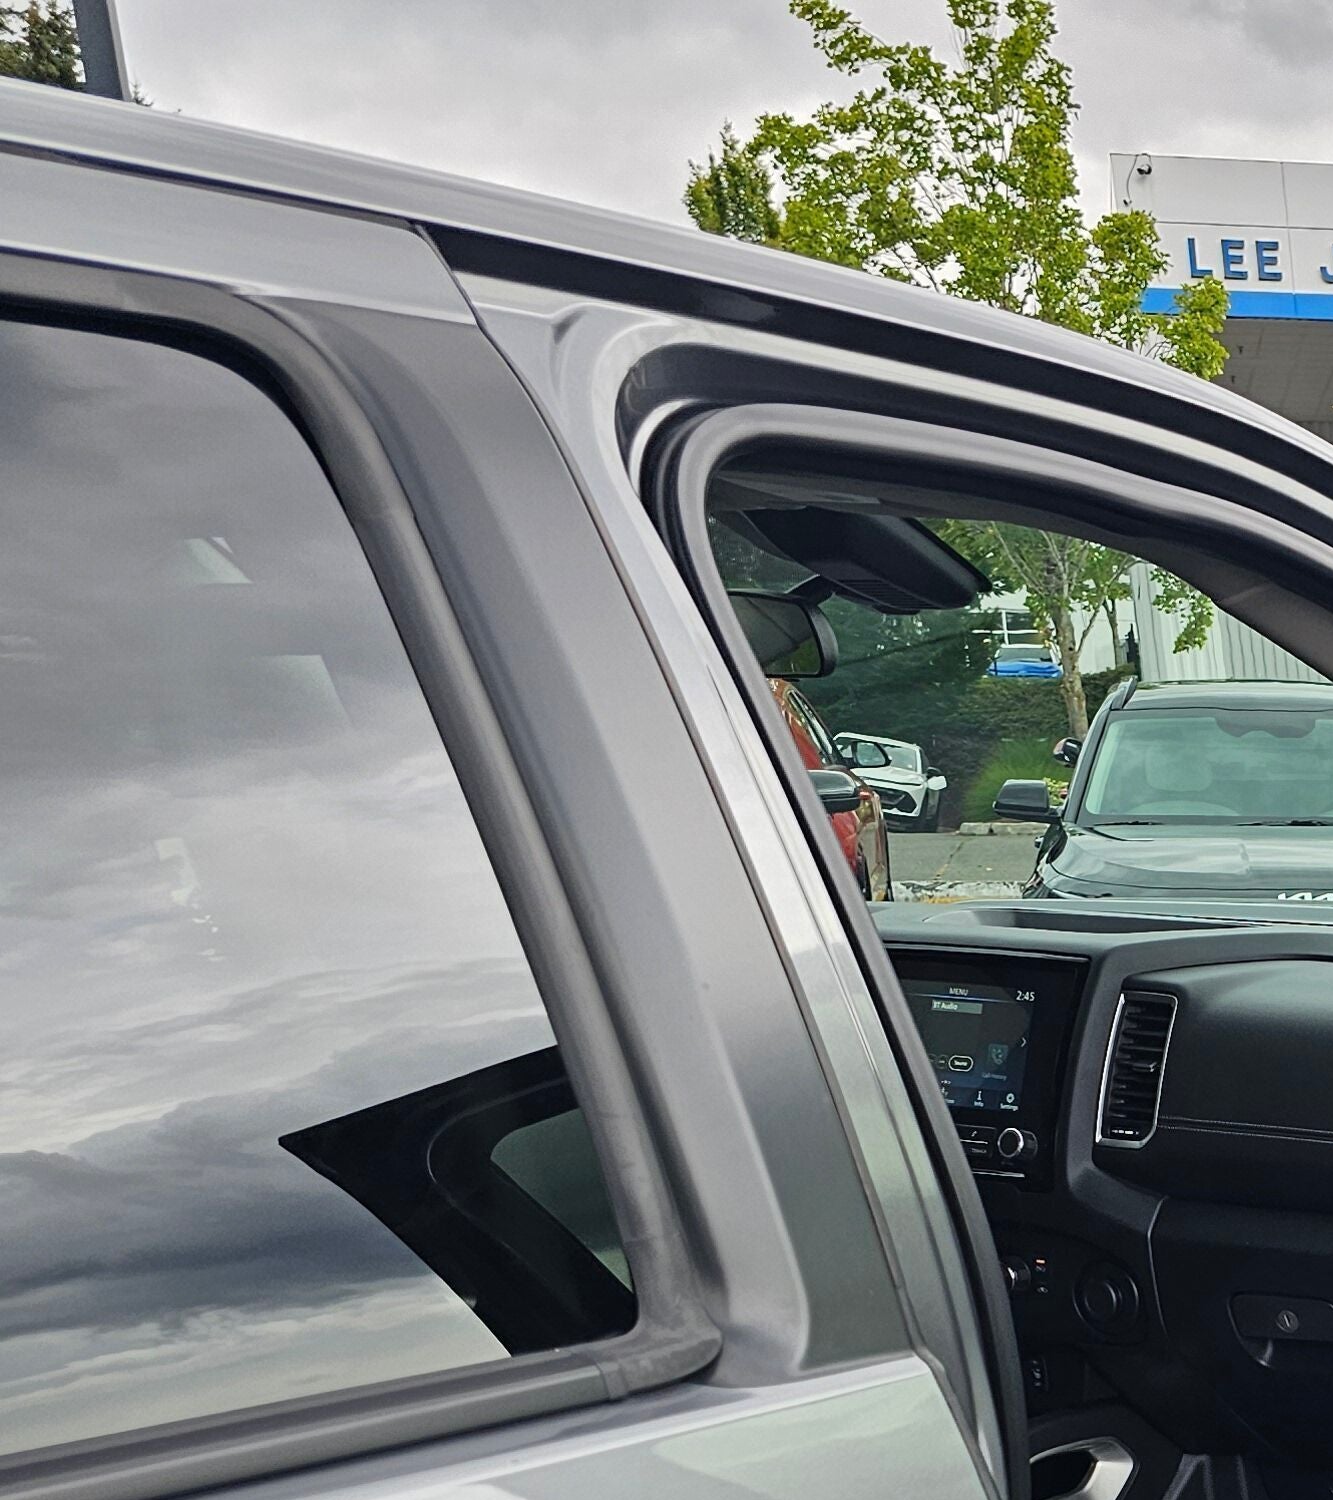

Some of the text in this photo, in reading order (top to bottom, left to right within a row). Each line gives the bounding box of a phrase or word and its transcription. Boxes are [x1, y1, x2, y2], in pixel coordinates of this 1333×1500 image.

[1186, 237, 1283, 282] LEE
[949, 987, 1036, 1002] MENU 2:45
